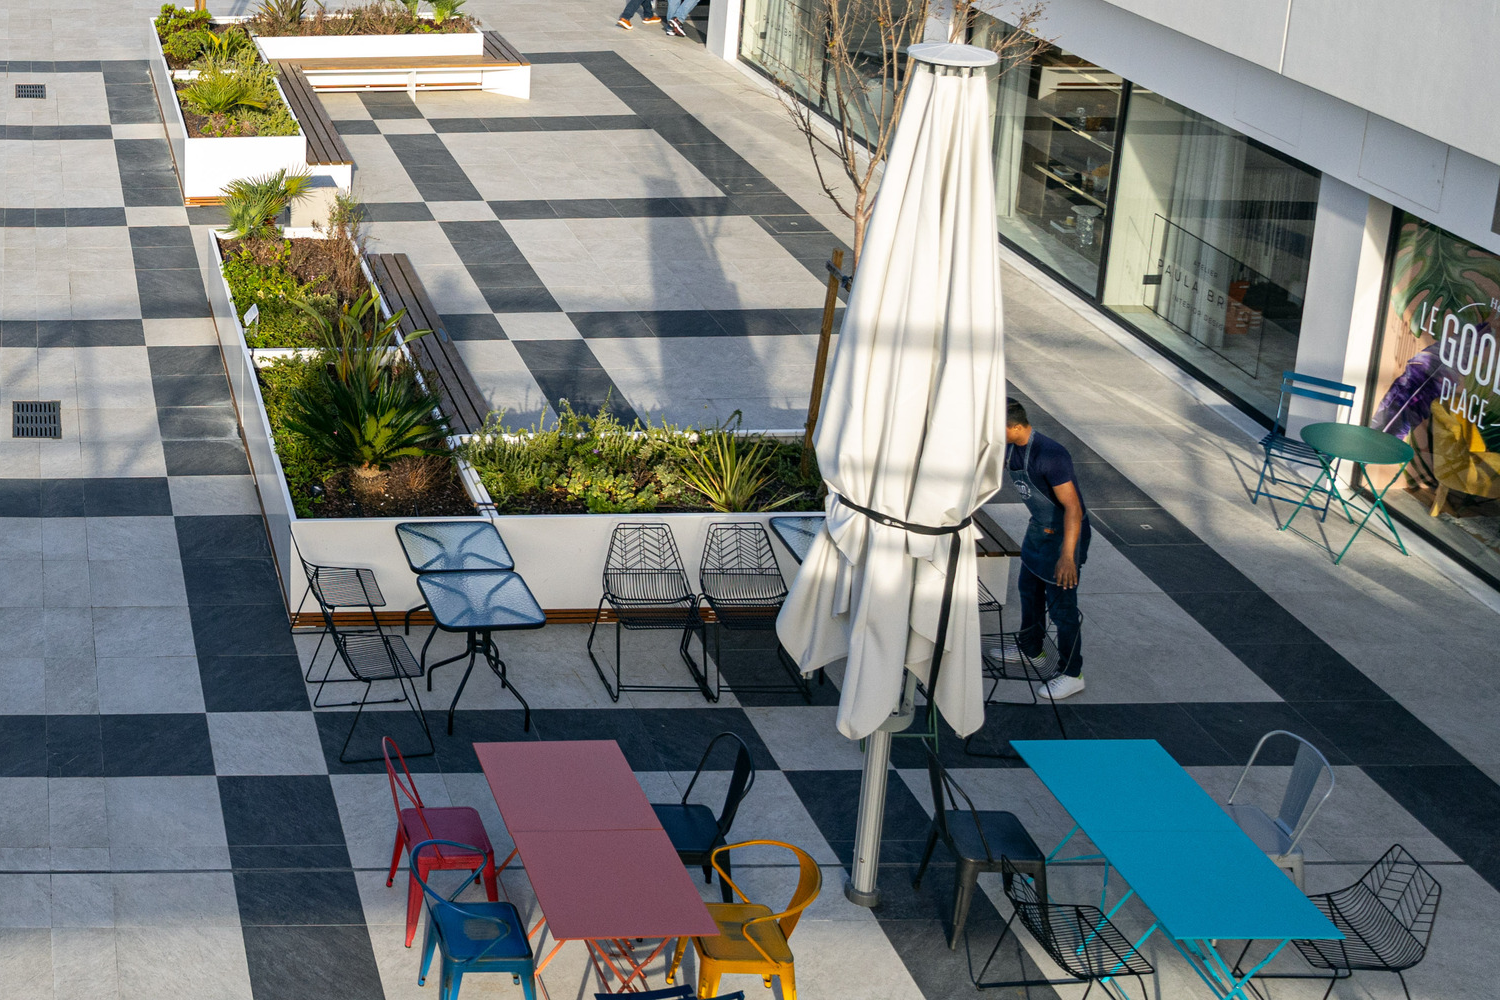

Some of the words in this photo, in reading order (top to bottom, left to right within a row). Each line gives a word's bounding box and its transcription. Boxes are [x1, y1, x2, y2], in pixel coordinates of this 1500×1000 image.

[1158, 258, 1199, 292] PAULA
[1419, 301, 1439, 336] LE
[1439, 376, 1489, 430] PLACE
